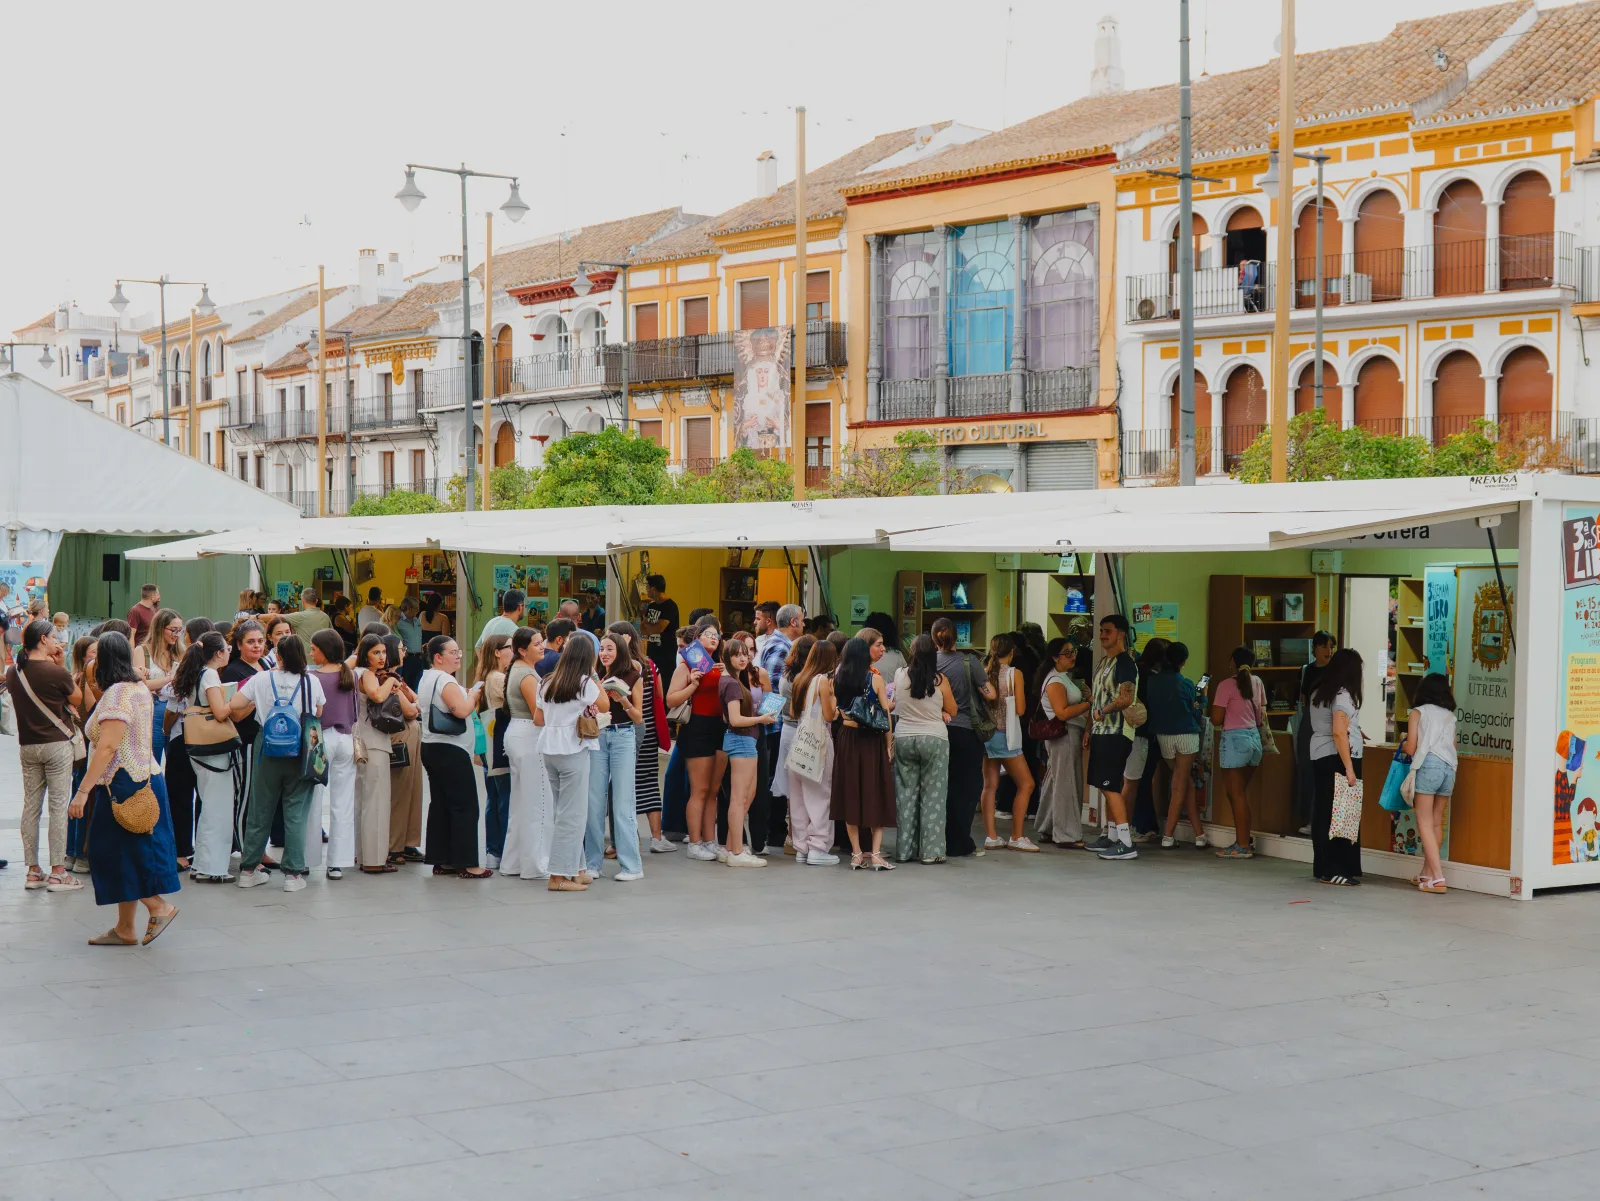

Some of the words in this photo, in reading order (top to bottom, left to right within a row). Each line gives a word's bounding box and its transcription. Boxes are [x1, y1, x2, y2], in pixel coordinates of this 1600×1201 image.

[968, 422, 1047, 441] CULTURAL
[1474, 474, 1518, 485] REMSA
[1428, 598, 1449, 622] LIBRO
[1588, 596, 1597, 610] 15
[1570, 655, 1597, 667] Programa
[1468, 682, 1508, 699] UTRERA
[1456, 730, 1470, 745] de
[1471, 731, 1514, 753] Cultura,
